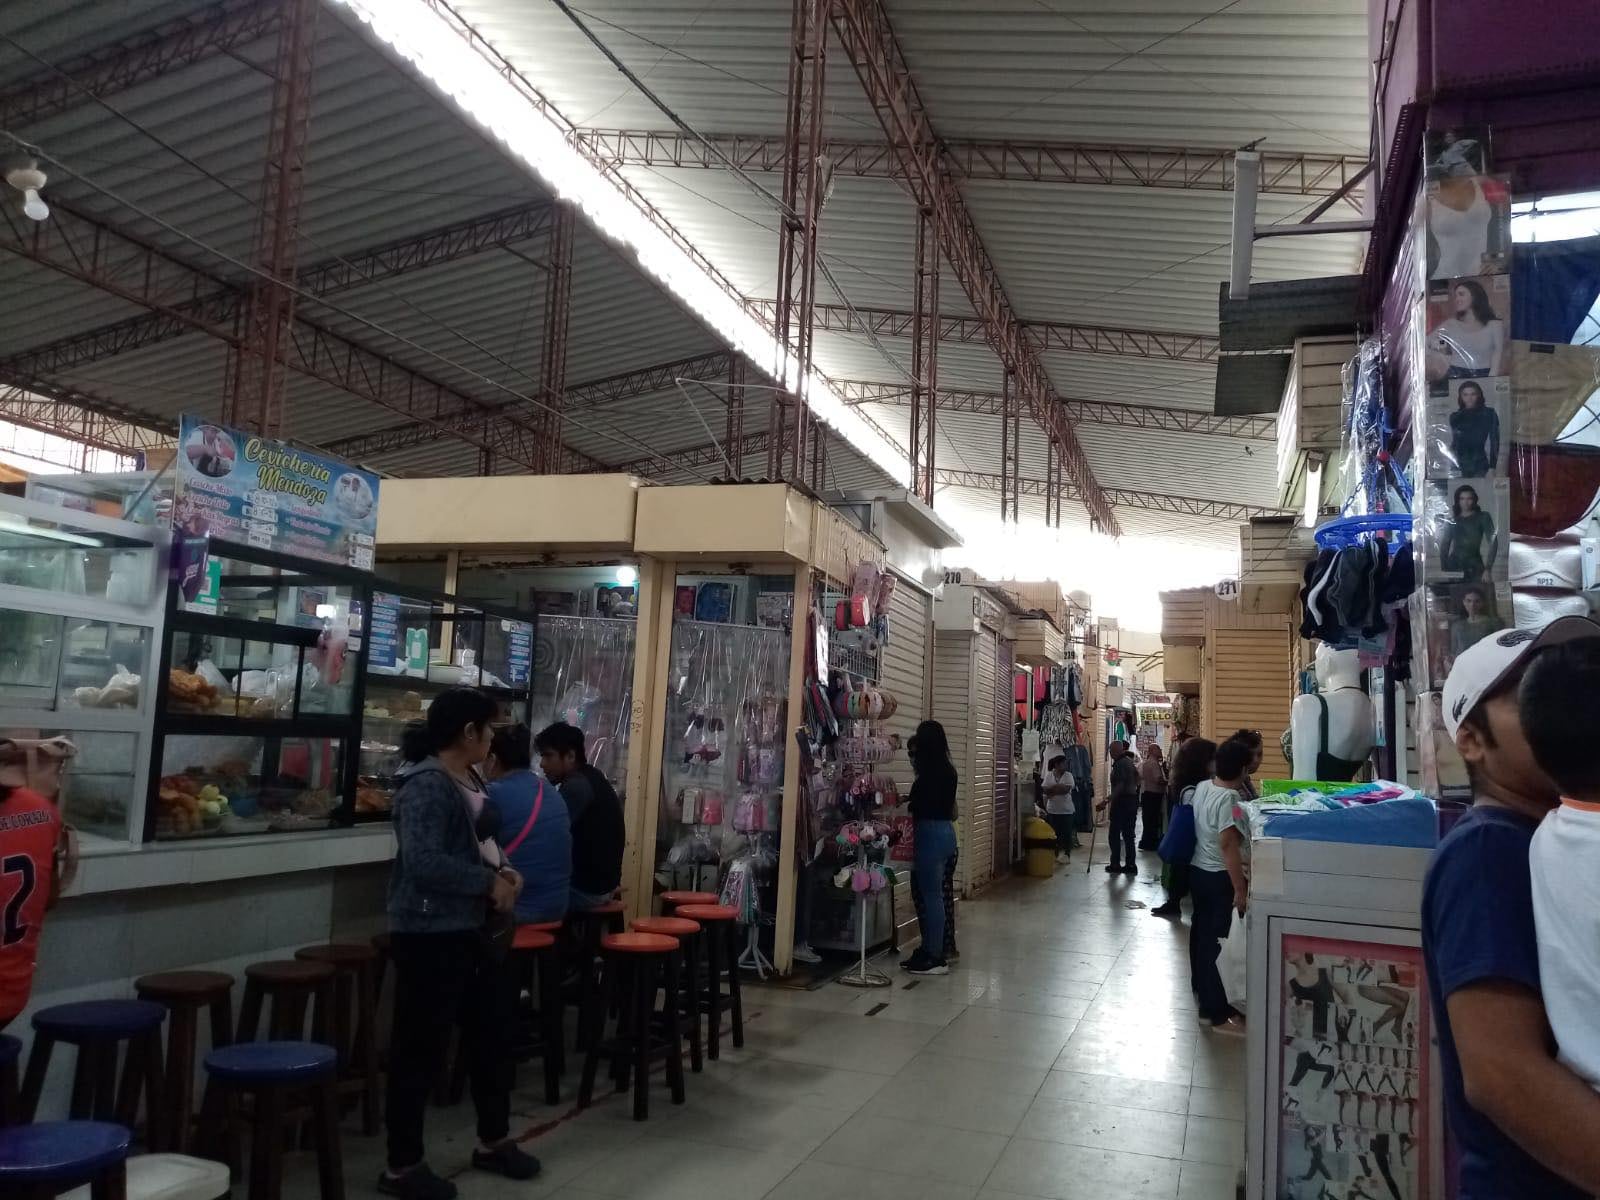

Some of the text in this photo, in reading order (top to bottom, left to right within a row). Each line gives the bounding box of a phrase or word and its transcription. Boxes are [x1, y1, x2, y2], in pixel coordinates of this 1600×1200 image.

[257, 465, 327, 505] Mendoza
[945, 572, 961, 584] 270
[1219, 581, 1236, 595] 271
